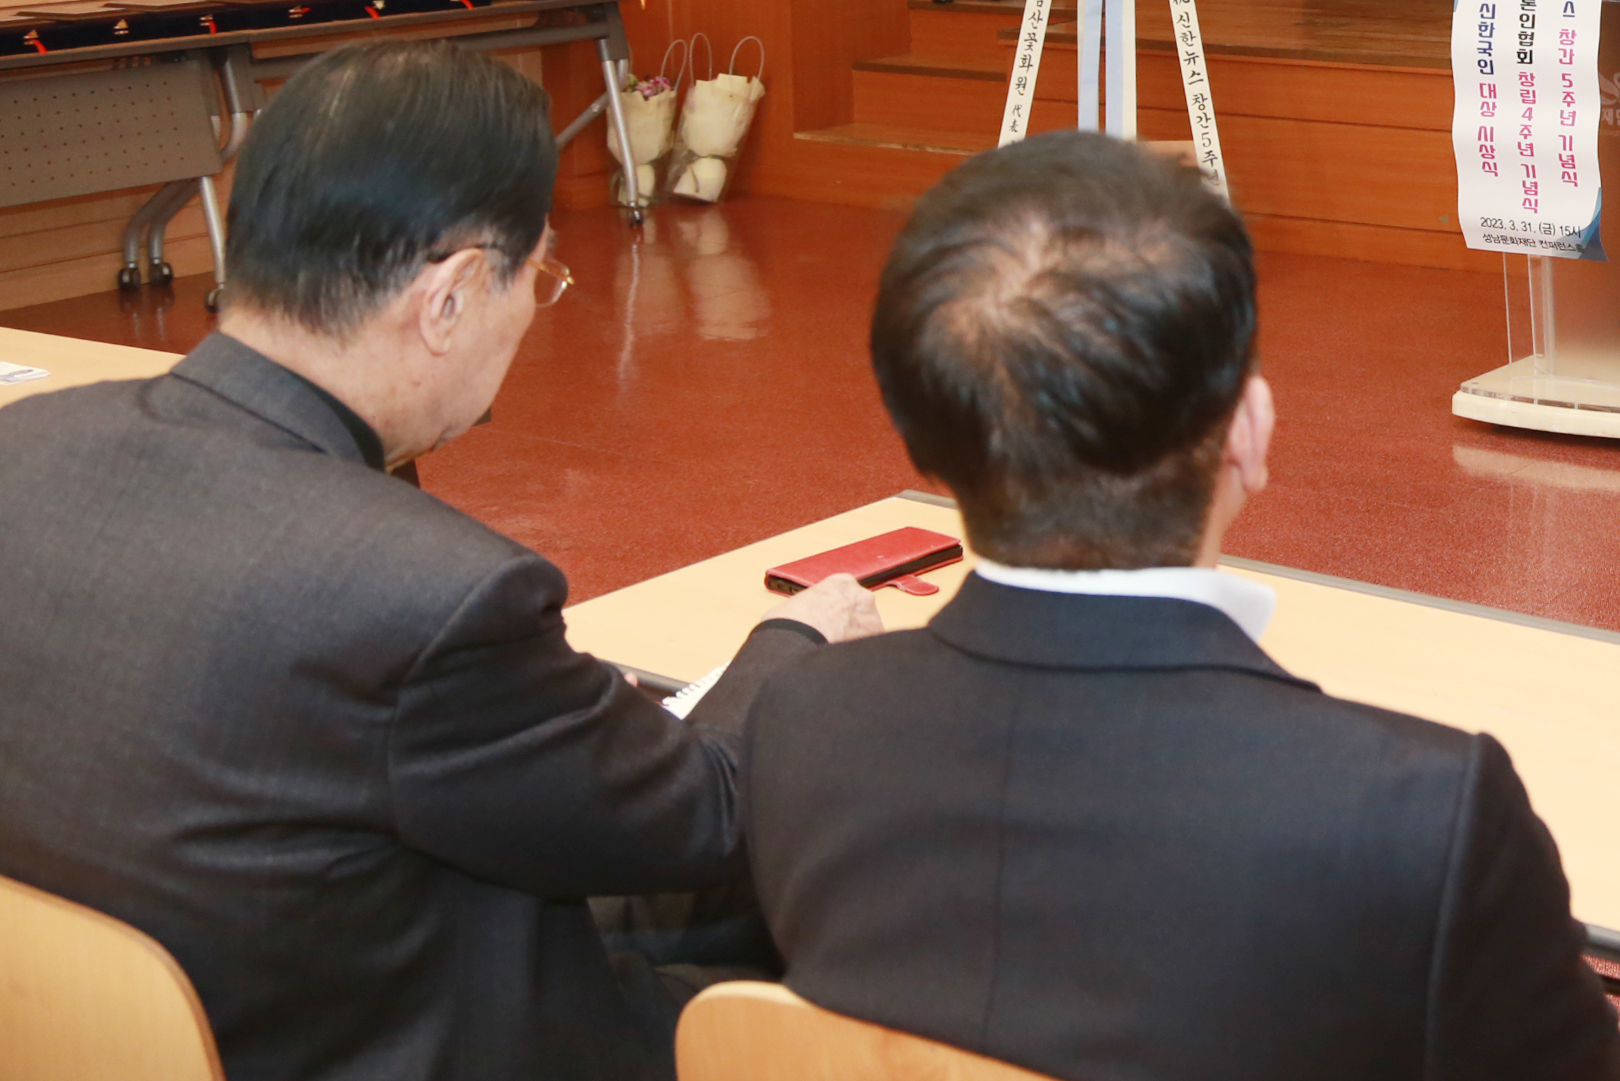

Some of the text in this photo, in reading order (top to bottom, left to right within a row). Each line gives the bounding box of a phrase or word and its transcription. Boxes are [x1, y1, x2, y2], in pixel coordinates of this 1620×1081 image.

[1176, 11, 1205, 86] 신한뉴스
[1477, 3, 1496, 75] 신한국인
[1558, 28, 1578, 66] 창간
[1479, 83, 1497, 118] 대상
[1559, 73, 1577, 127] 5주년
[1477, 126, 1499, 177] 시상식
[1558, 135, 1579, 188] 기념식
[1520, 163, 1539, 214] 기념식
[1480, 216, 1507, 231] 2023.
[1508, 219, 1519, 232] 3.
[1538, 221, 1556, 236] (금)
[1559, 224, 1582, 239] 15시
[1482, 233, 1537, 248] 성남문화재단
